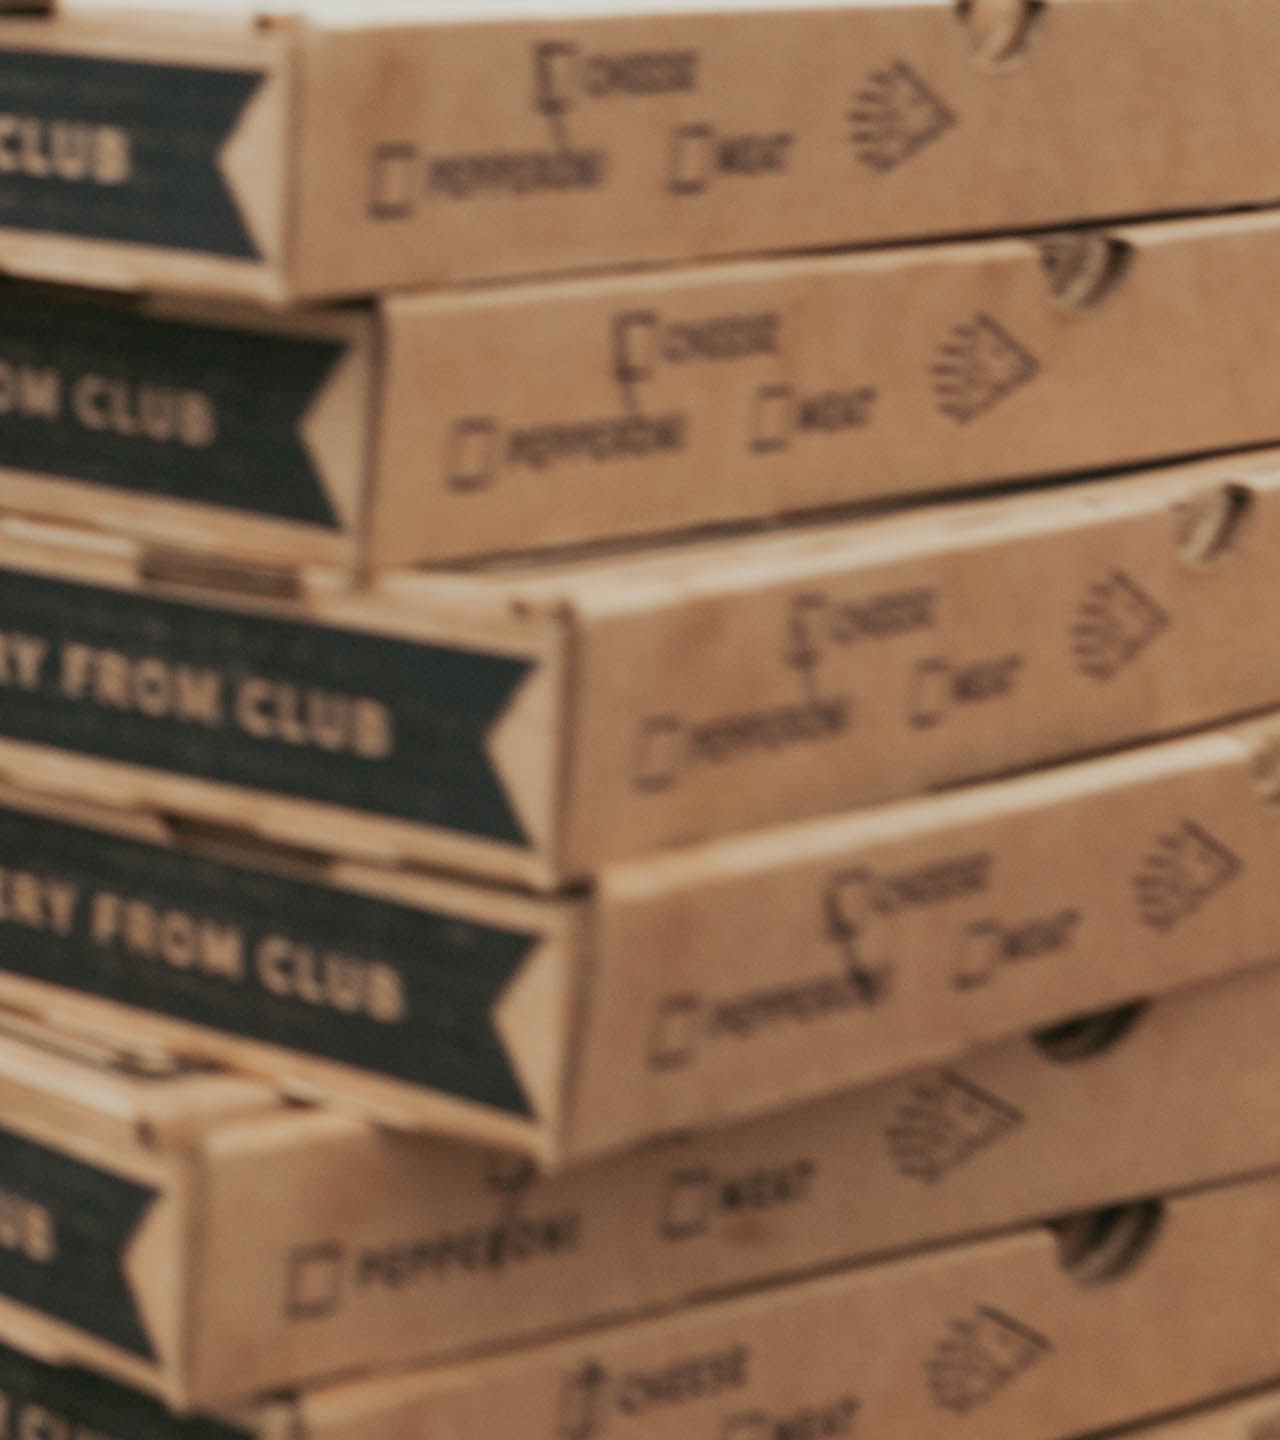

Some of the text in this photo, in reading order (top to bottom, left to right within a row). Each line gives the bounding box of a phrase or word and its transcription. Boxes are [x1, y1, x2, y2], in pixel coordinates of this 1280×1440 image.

[74, 373, 216, 448] CLUB
[61, 643, 221, 726] FROM
[238, 677, 391, 758] CLUB
[90, 888, 243, 981] FROM
[259, 939, 407, 1022] CLUB
